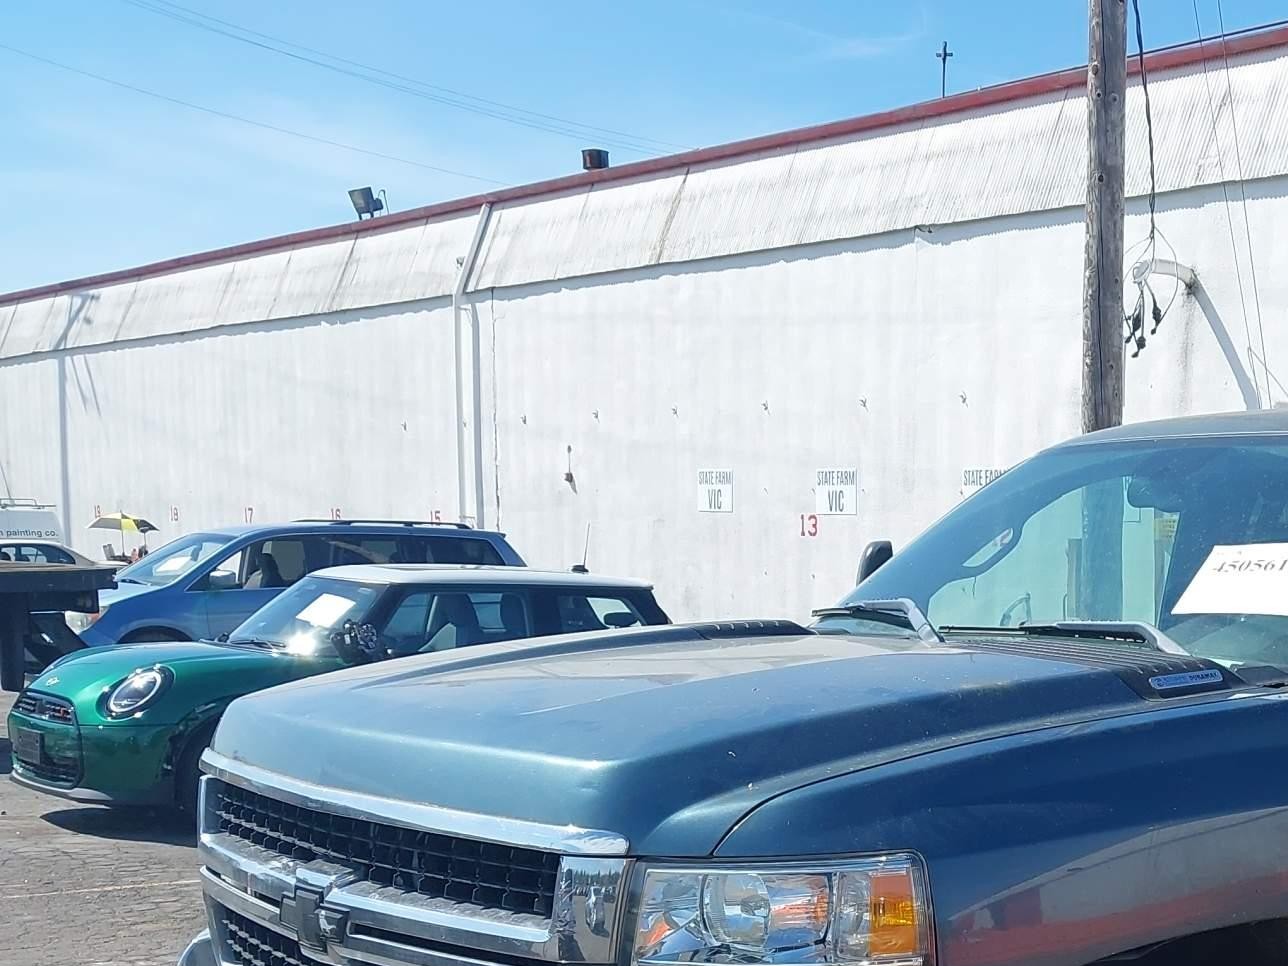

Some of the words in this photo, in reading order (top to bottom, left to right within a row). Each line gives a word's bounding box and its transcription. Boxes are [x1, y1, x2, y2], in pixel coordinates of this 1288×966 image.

[699, 471, 714, 485] STATE
[715, 471, 732, 485] FARM
[817, 471, 835, 486] STATE
[836, 471, 855, 486] FARM
[963, 470, 983, 486] STATE
[708, 489, 722, 509] VIC
[828, 490, 845, 512] VIC
[244, 507, 254, 523] 17
[6, 529, 43, 538] painting
[800, 514, 818, 537] 13
